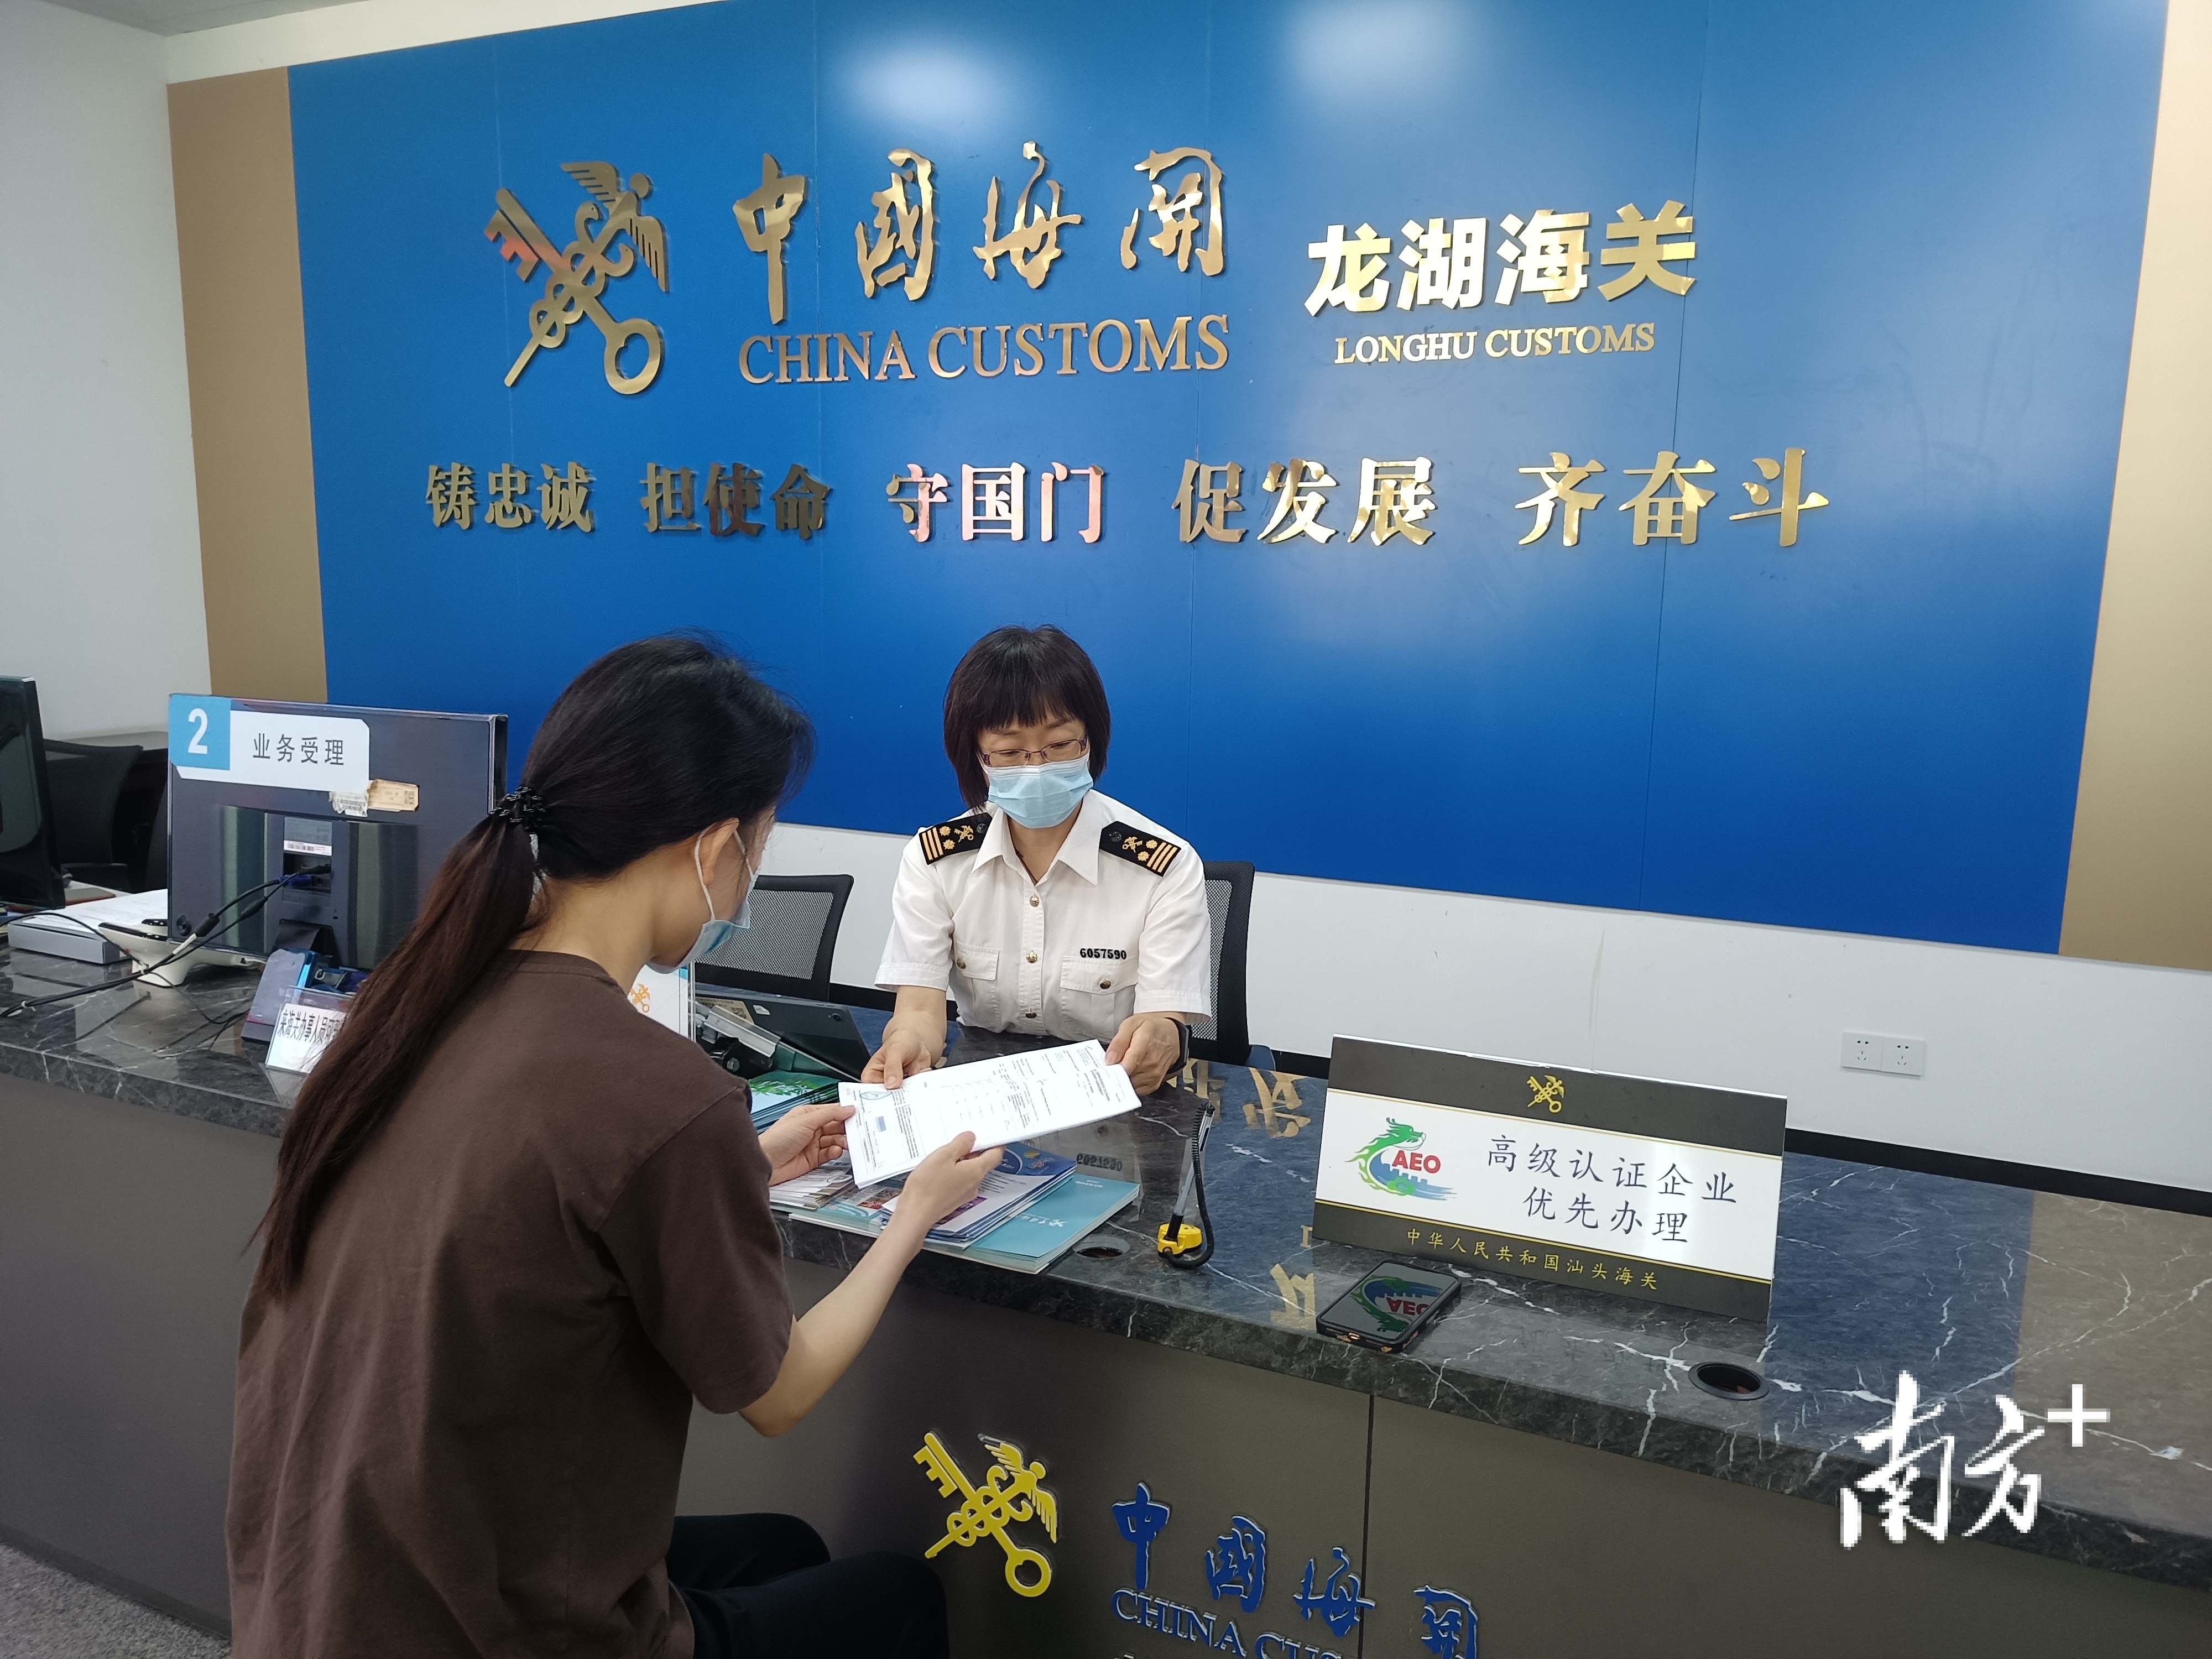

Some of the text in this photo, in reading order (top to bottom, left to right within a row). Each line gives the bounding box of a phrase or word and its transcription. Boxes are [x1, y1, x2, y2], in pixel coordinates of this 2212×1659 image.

[1304, 199, 1698, 316] 龙湖海关
[738, 315, 1230, 383] CHINA CUSTOMS
[1335, 322, 1656, 364] LONGHU CUSTOMS
[426, 447, 1830, 547] 铸忠诚 担使命 守国门 促发展 齐奋斗
[187, 708, 209, 755] 2
[253, 733, 345, 766] 业务受理
[1079, 947, 1127, 960] 6057590
[1391, 1149, 1441, 1175] AEO
[1487, 1134, 1737, 1204] 高级认证企业
[1522, 1186, 1689, 1244] 优先办理
[1406, 1227, 1658, 1291] 中华人民共和国汕头海关
[1112, 1588, 1246, 1657] CHINA
